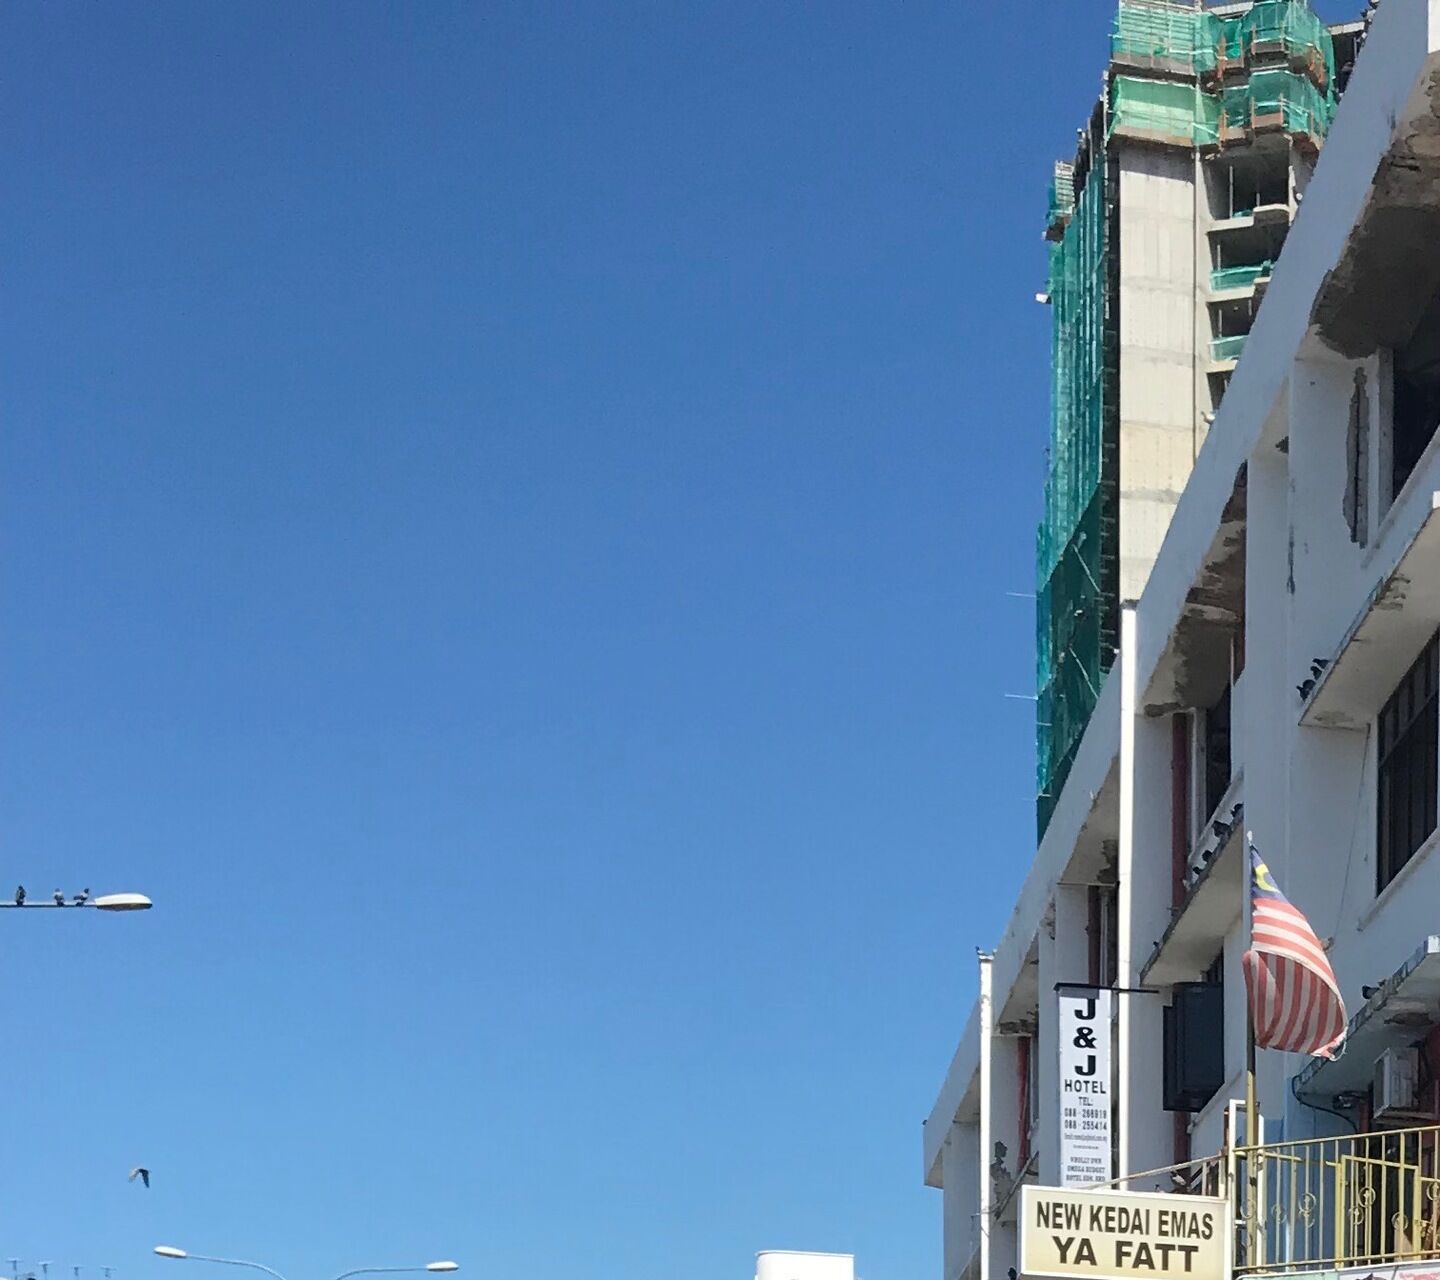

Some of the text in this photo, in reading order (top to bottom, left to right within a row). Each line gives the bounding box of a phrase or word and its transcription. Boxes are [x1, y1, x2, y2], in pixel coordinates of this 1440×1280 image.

[1073, 998, 1097, 1077] J & J
[1064, 1079, 1107, 1094] HOTEL
[1036, 1201, 1213, 1241] NEW KEDAI EMAS
[1052, 1235, 1199, 1272] YA FATT
